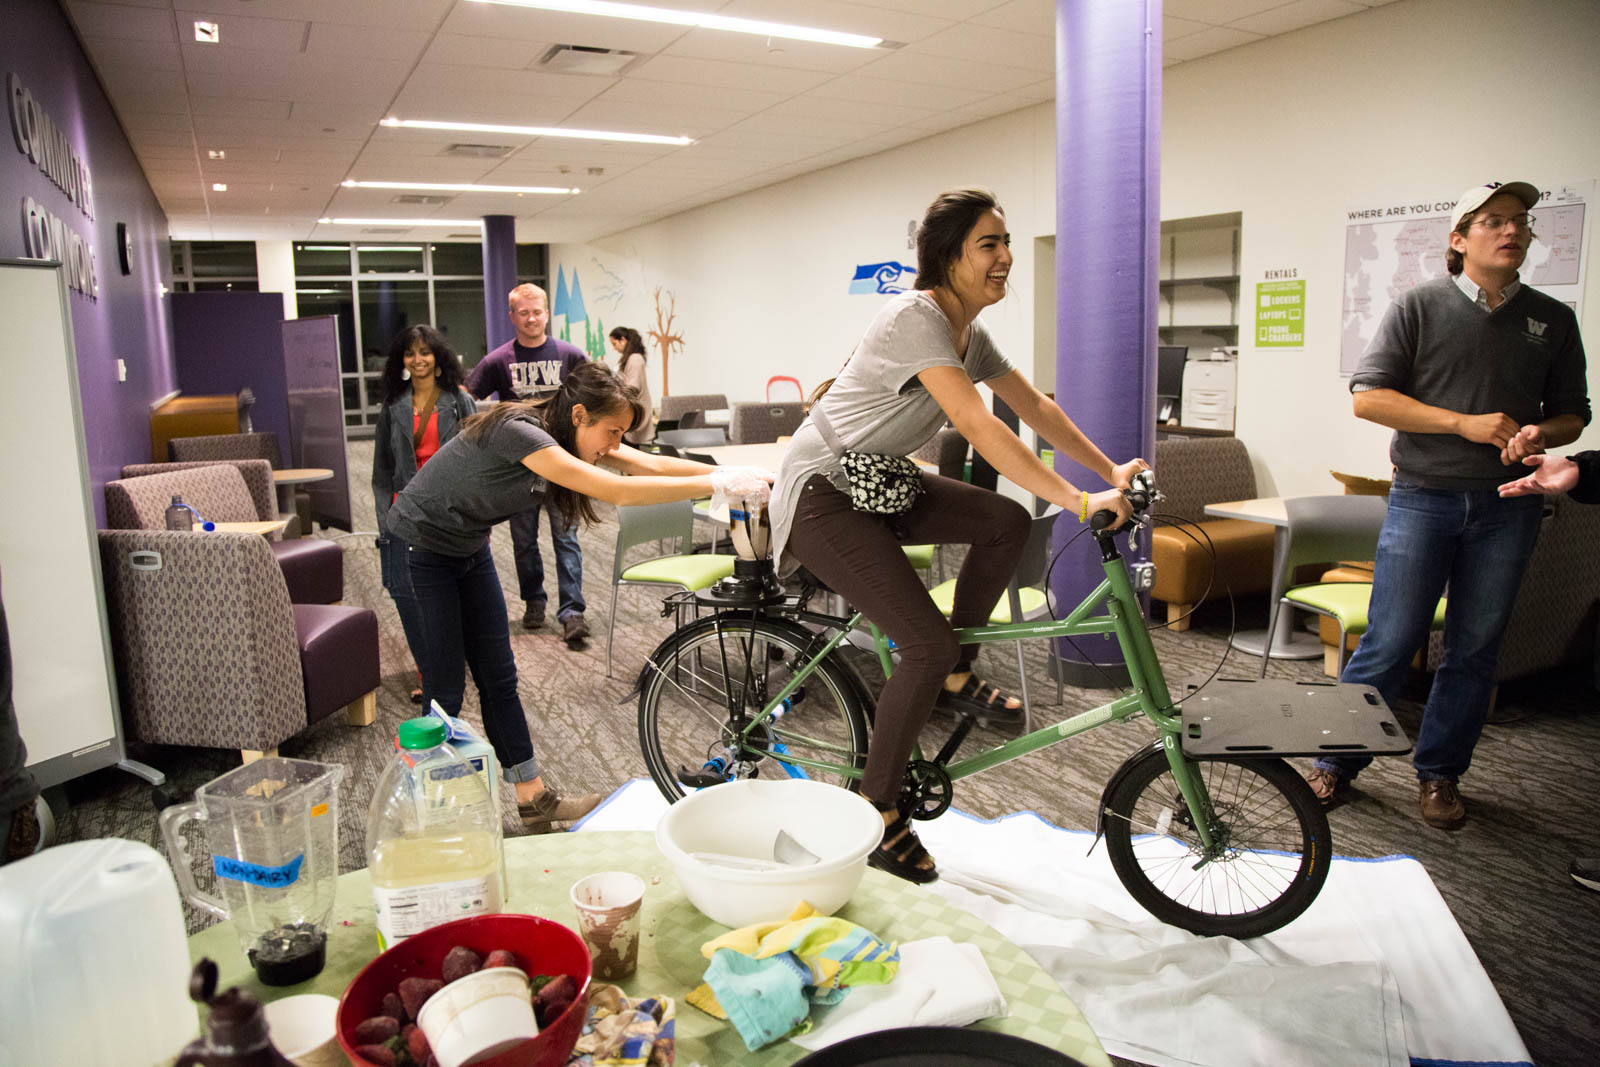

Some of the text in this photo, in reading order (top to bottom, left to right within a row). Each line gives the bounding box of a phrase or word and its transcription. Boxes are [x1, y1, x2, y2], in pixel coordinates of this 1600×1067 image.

[7, 72, 96, 222] COMMUTER
[1348, 201, 1458, 220] WHERE ARE YOU COM
[22, 196, 97, 304] COMMONS
[1264, 268, 1298, 280] RENTALS
[1271, 295, 1301, 305] LOCKERS
[1260, 310, 1287, 320] LAPTOPS
[1268, 325, 1289, 334] PHONE
[1527, 316, 1548, 336] W
[1268, 333, 1303, 343] CHARGERS
